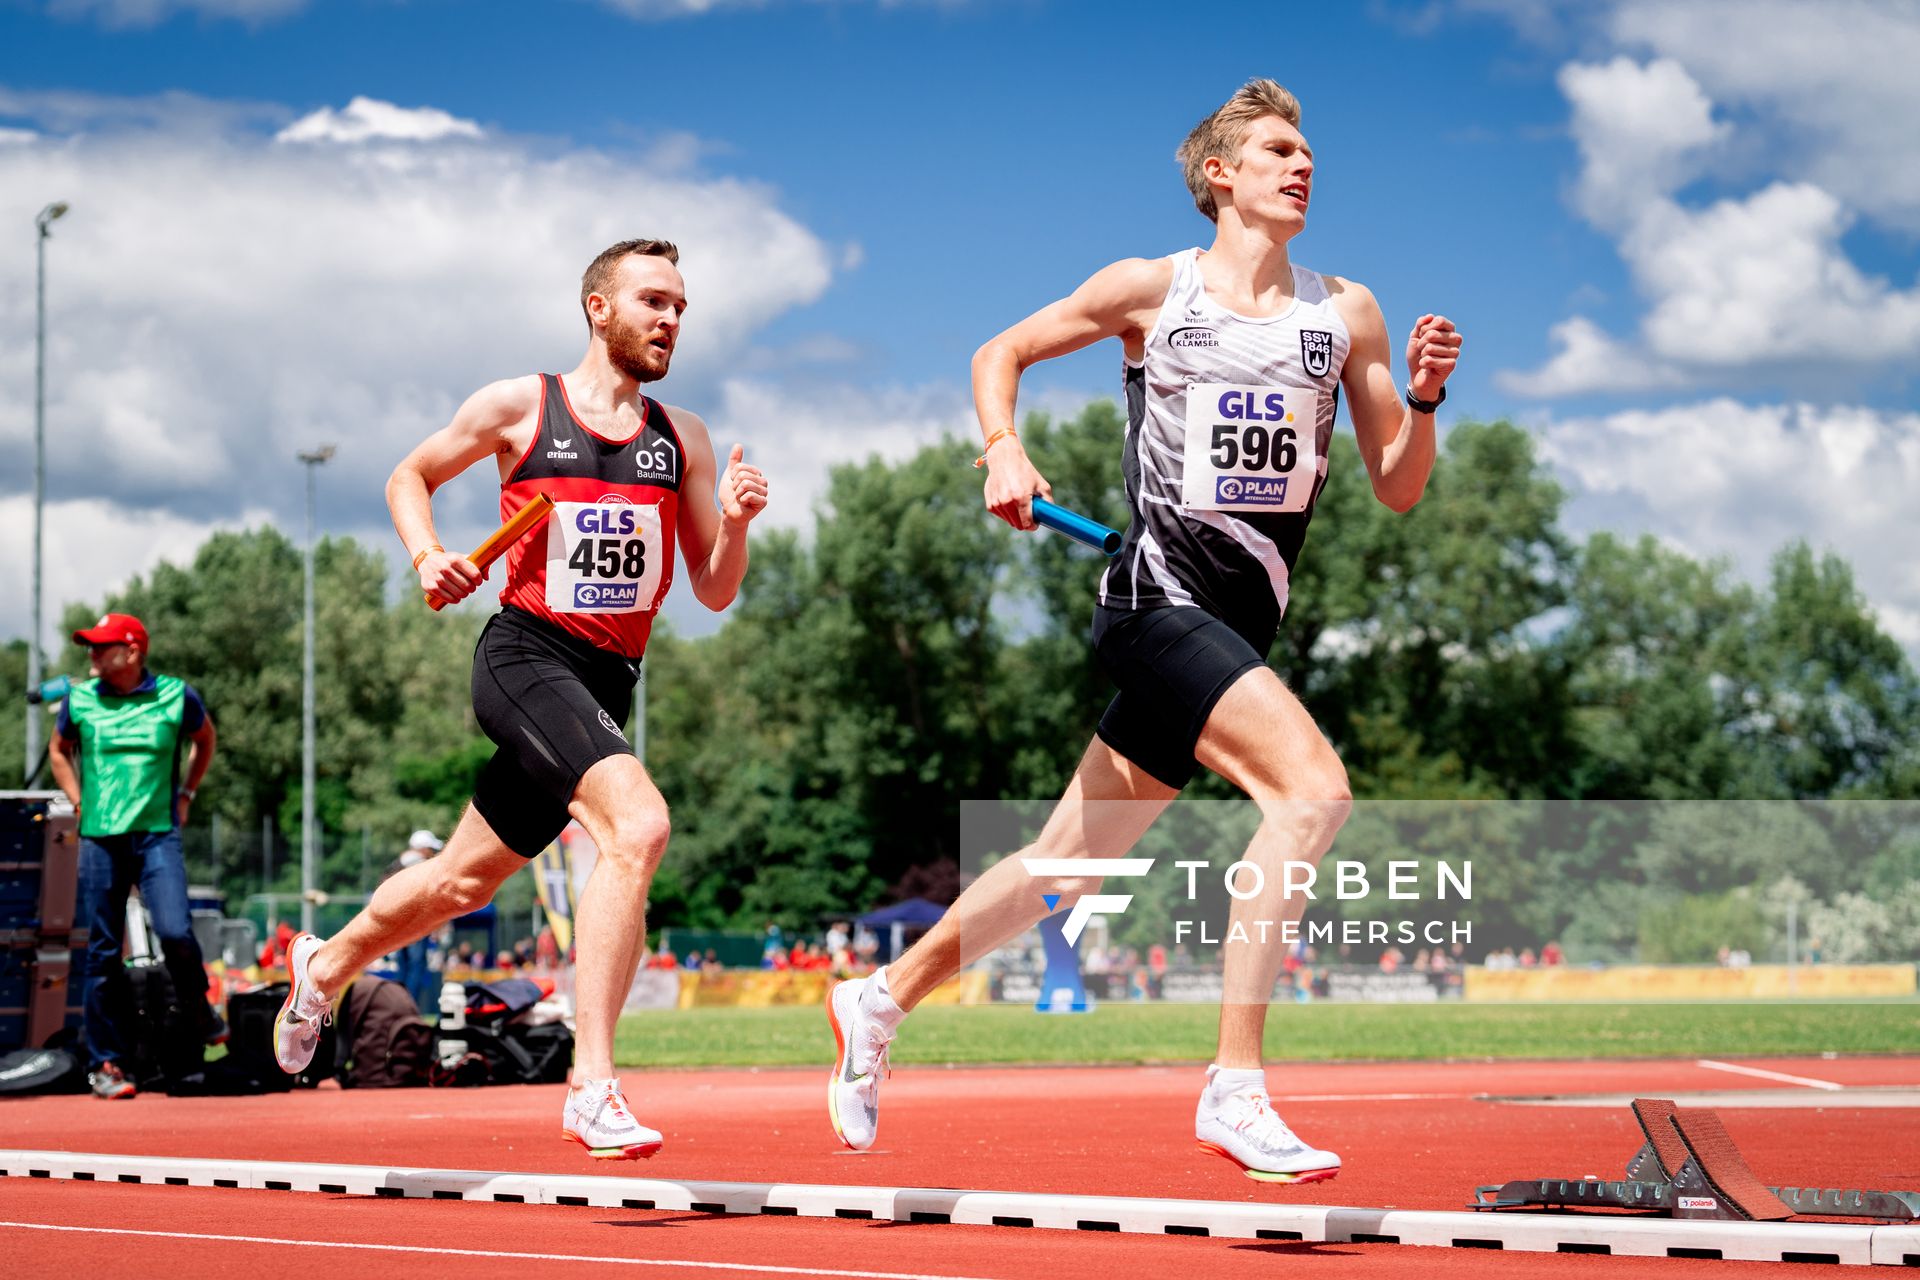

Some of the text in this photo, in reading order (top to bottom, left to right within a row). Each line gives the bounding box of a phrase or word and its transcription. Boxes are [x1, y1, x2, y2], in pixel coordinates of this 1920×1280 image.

[1302, 332, 1329, 344] SSV
[1303, 342, 1330, 354] 1846
[1210, 424, 1297, 472] 596
[547, 451, 578, 459] erima
[635, 450, 667, 471] OS
[1245, 482, 1285, 496] PLAN
[568, 538, 646, 579] 458
[602, 587, 636, 599] PLAN
